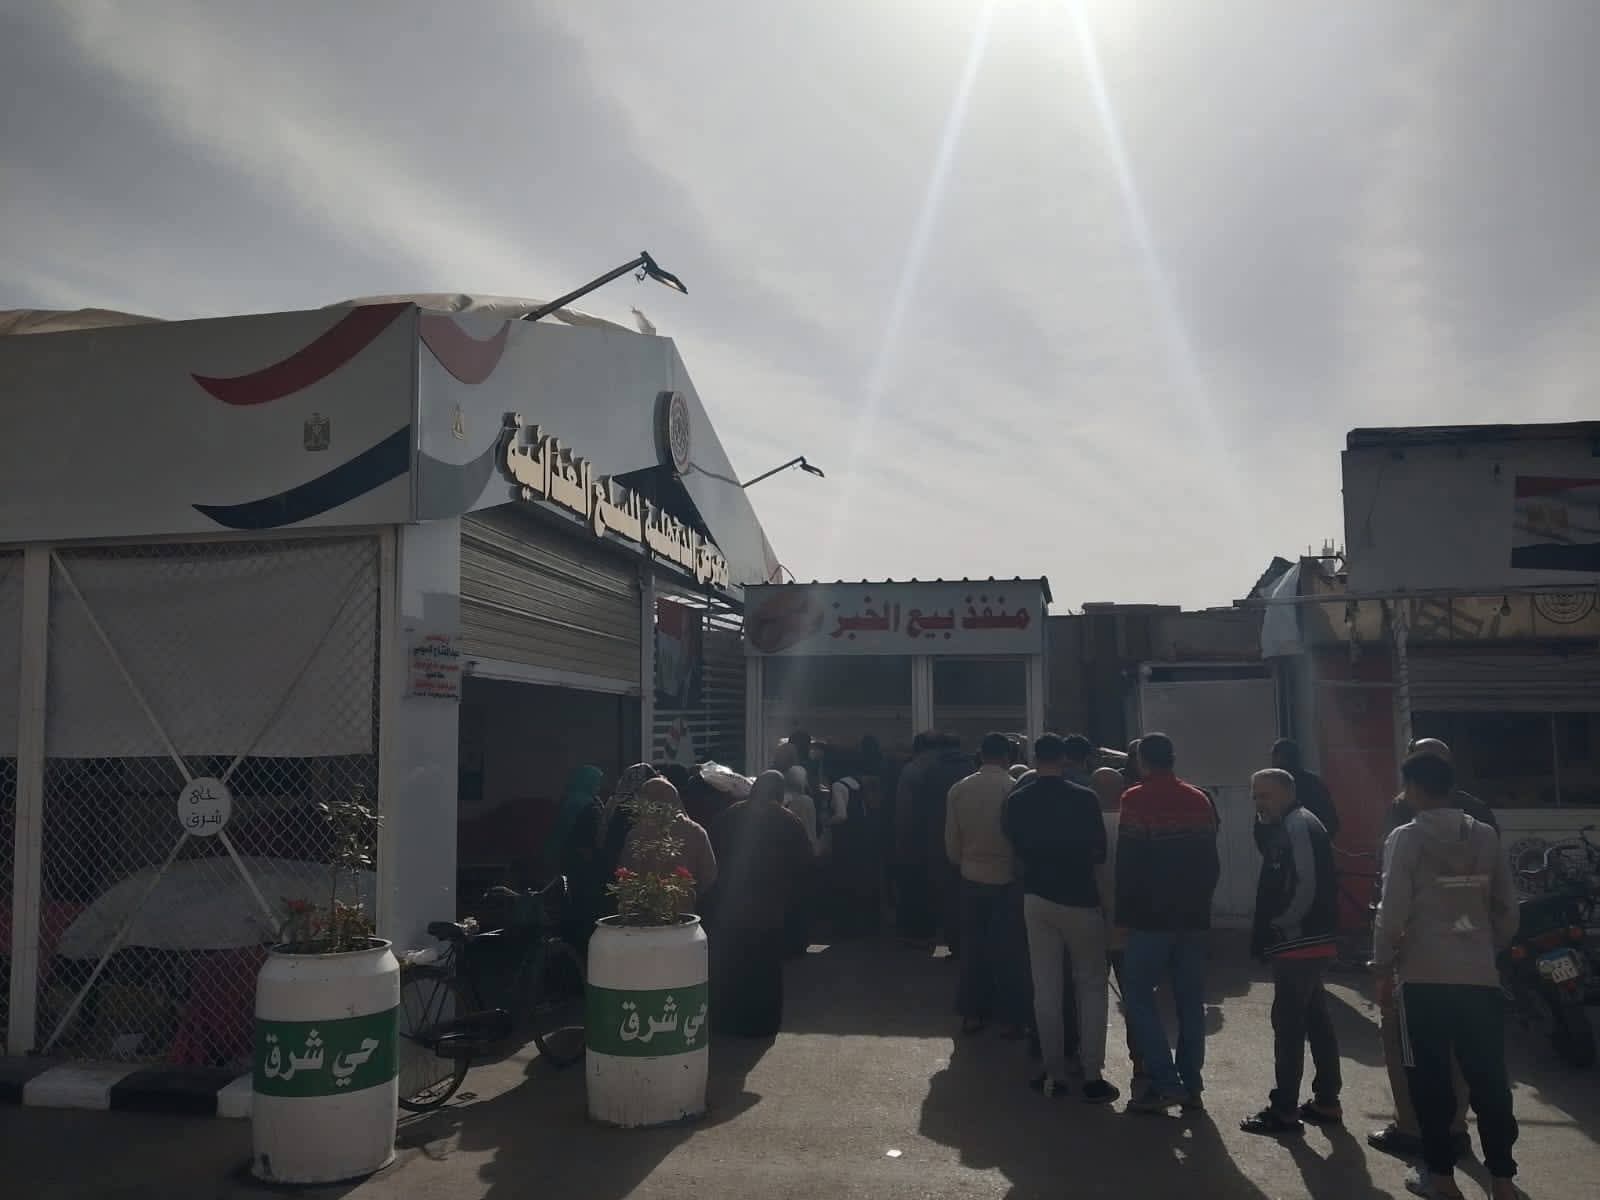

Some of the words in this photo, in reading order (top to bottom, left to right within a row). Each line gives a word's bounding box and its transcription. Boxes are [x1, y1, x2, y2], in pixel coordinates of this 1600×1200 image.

[503, 412, 593, 521] الغذائية
[829, 595, 901, 640] الخبز
[906, 606, 955, 640] بيع
[961, 595, 1031, 631] منفذ
[186, 808, 222, 829] شرق
[619, 994, 679, 1043] شرق
[263, 1028, 325, 1081] شرق
[331, 1036, 380, 1087] حي
